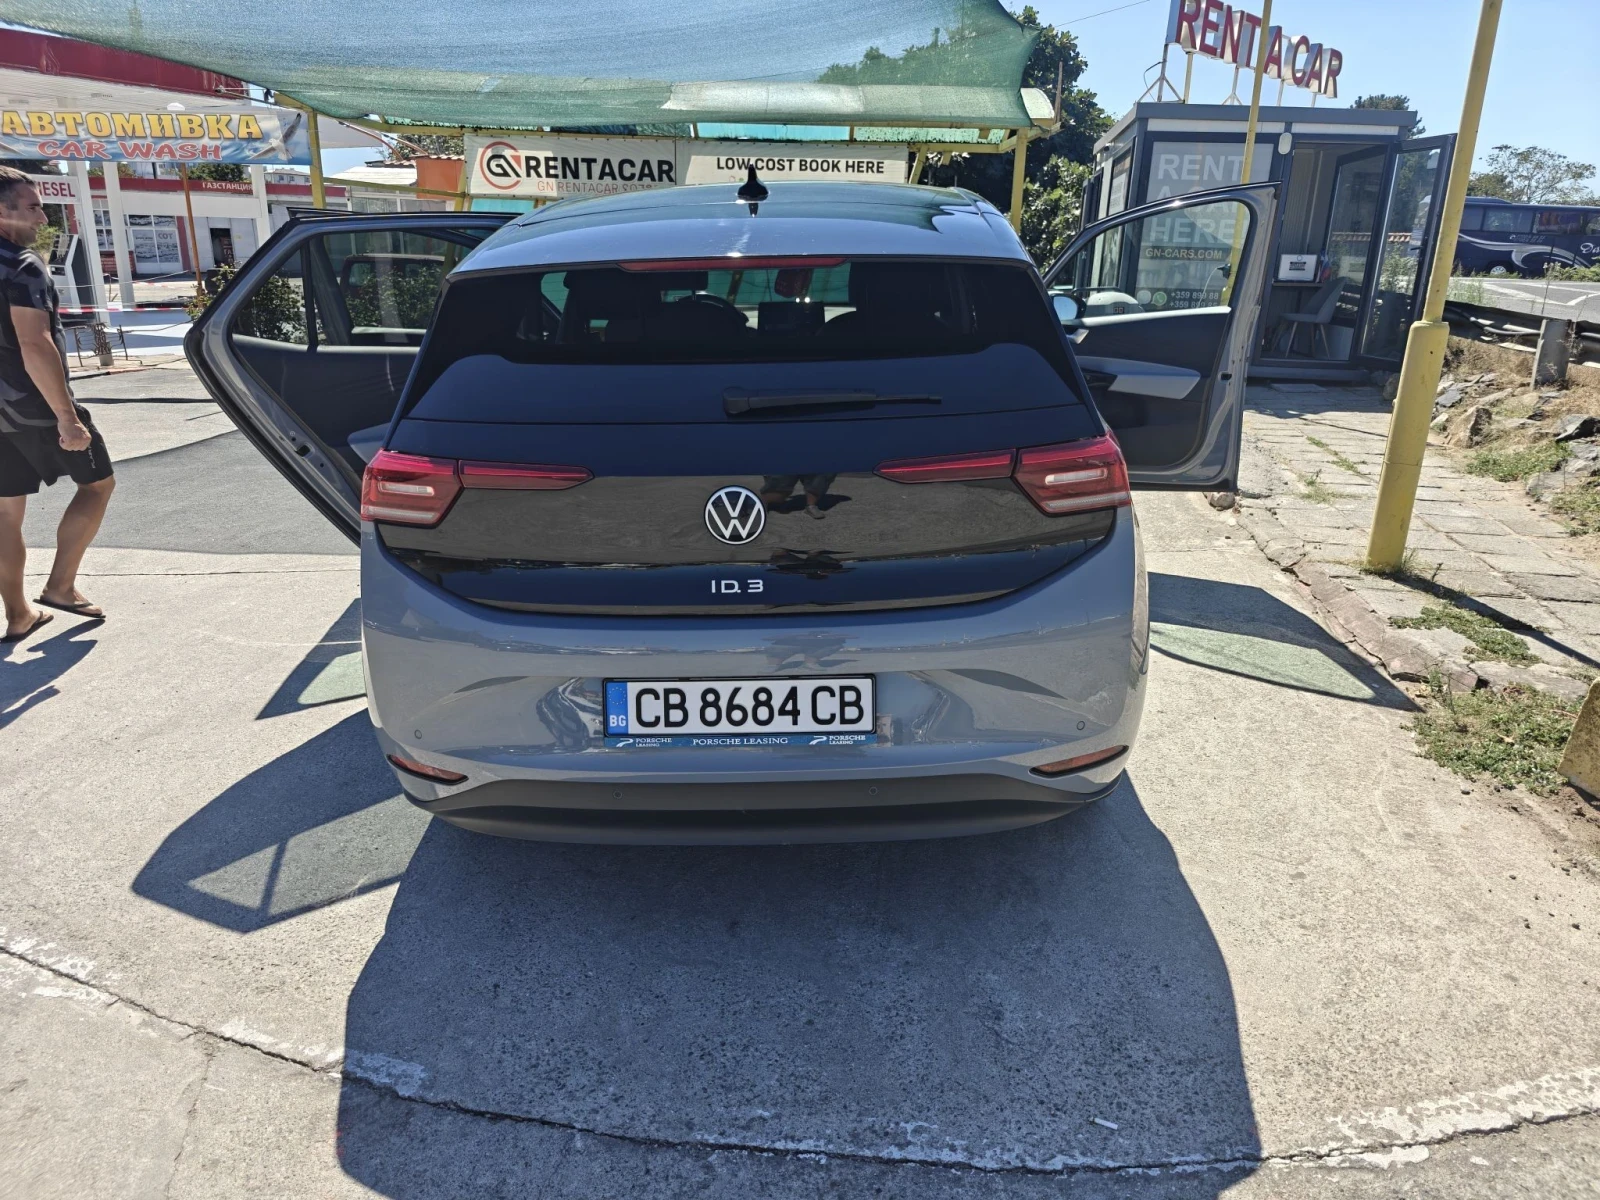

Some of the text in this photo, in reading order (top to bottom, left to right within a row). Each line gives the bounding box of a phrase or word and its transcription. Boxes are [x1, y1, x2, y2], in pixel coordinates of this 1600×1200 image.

[1175, 0, 1343, 98] RENT A CAR
[2, 111, 263, 139] АВТОМИВКА
[37, 141, 223, 161] CAR WASH
[524, 155, 675, 183] RENTACAR
[717, 157, 884, 174] LOW COST BOOK HERE
[1157, 153, 1246, 182] RENT
[37, 181, 76, 197] IESEL
[537, 181, 554, 192] GN
[557, 182, 618, 194] RENTACAR
[1145, 248, 1223, 259] GN-CARS.COM
[1171, 291, 1190, 299] +359
[699, 685, 800, 727] 8684
[609, 714, 627, 727] BG
[692, 737, 789, 746] PORSCHE LEASING
